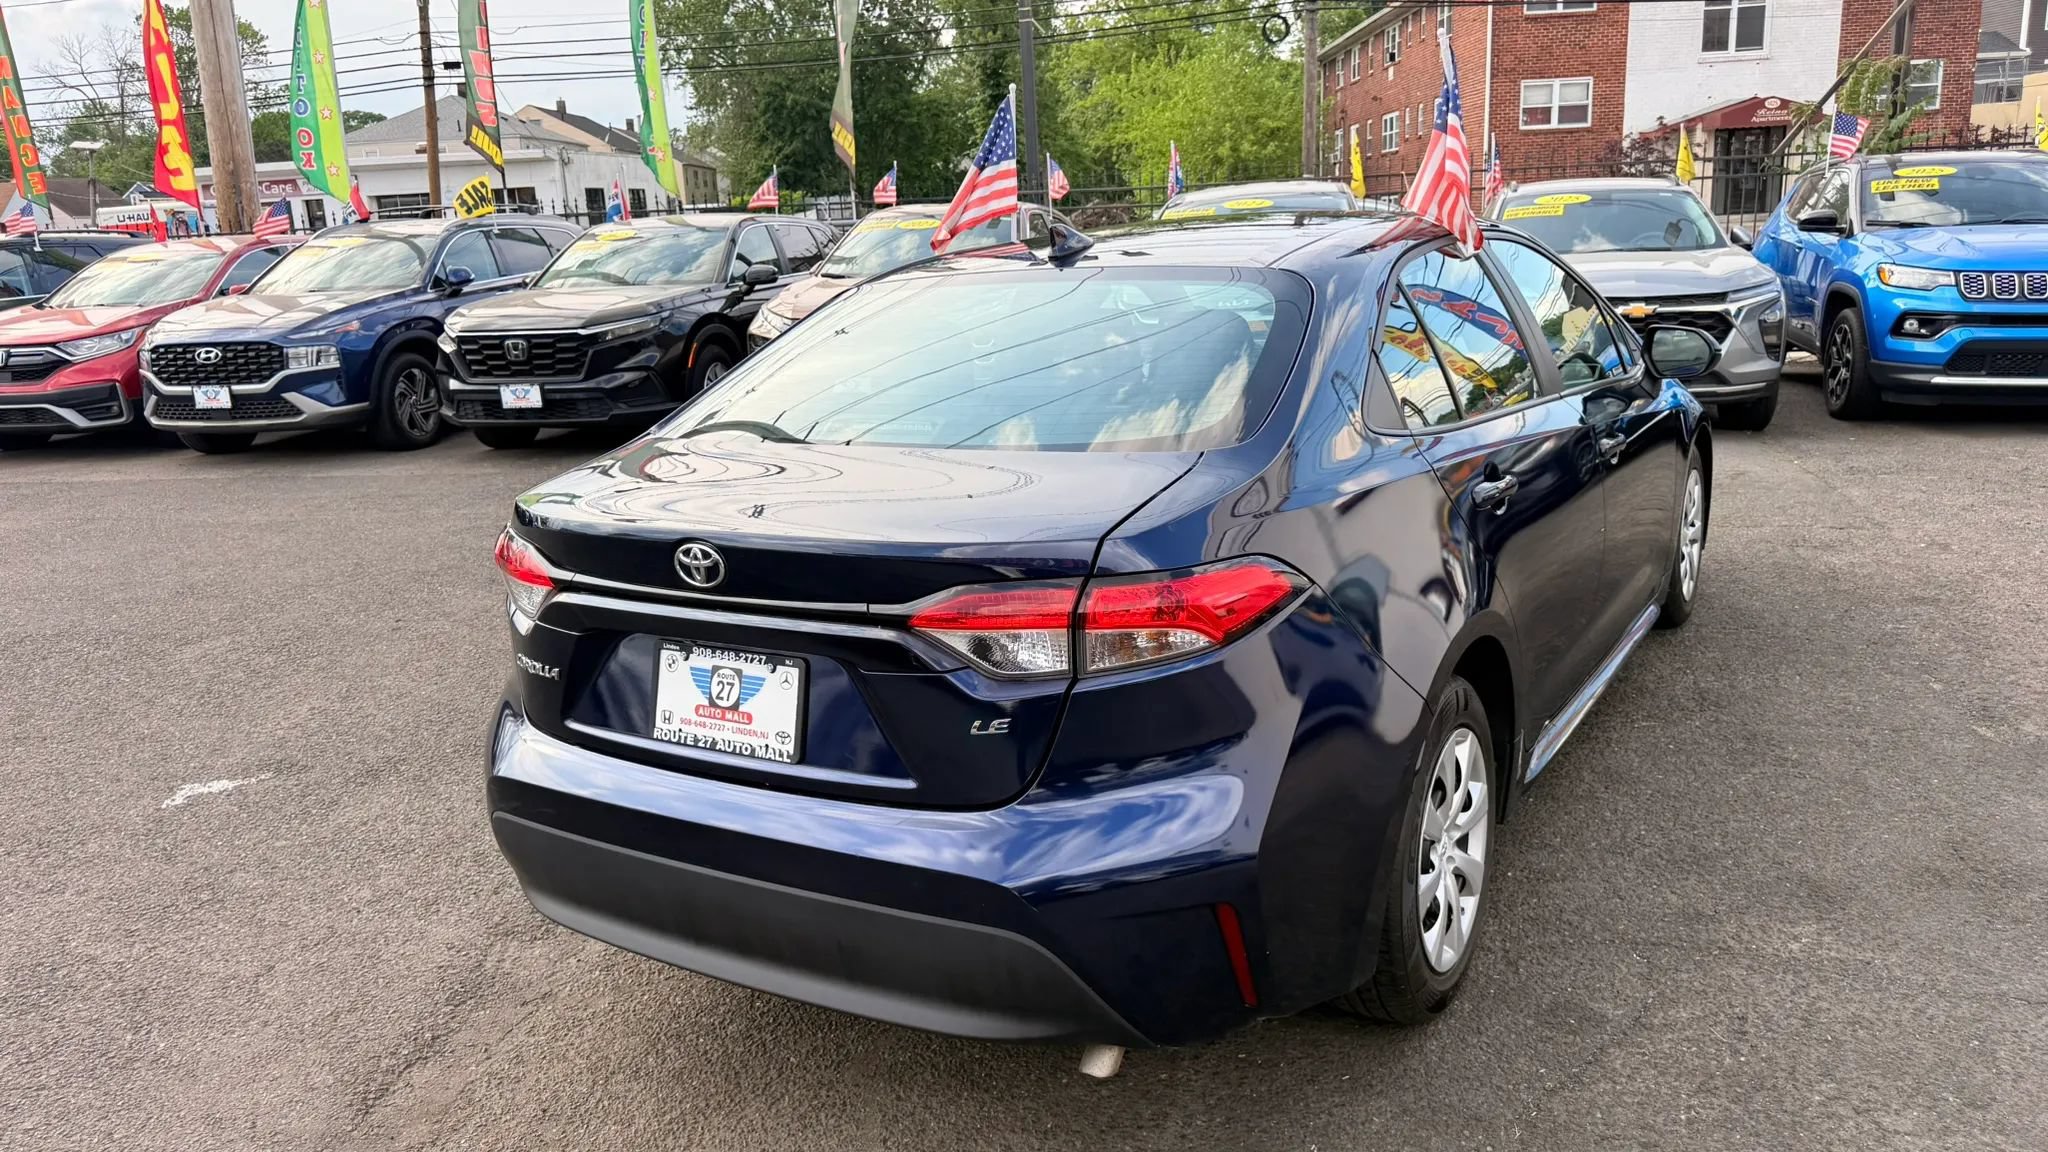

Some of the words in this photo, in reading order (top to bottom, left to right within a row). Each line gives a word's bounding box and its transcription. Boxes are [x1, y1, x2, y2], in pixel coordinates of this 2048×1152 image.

[1874, 183, 1937, 192] LEATHER
[663, 642, 680, 650] Linden
[692, 646, 767, 666] 908-648-2727
[716, 672, 736, 681] ROUTE
[715, 680, 735, 702] 27
[697, 706, 723, 717] AUTO
[725, 711, 749, 723] MALL
[679, 717, 726, 732] 908-648-2727
[970, 718, 1012, 735] LE
[653, 727, 696, 746] ROUTE
[697, 736, 714, 749] 27
[715, 738, 752, 756] AUTO
[754, 745, 791, 763] MALL
